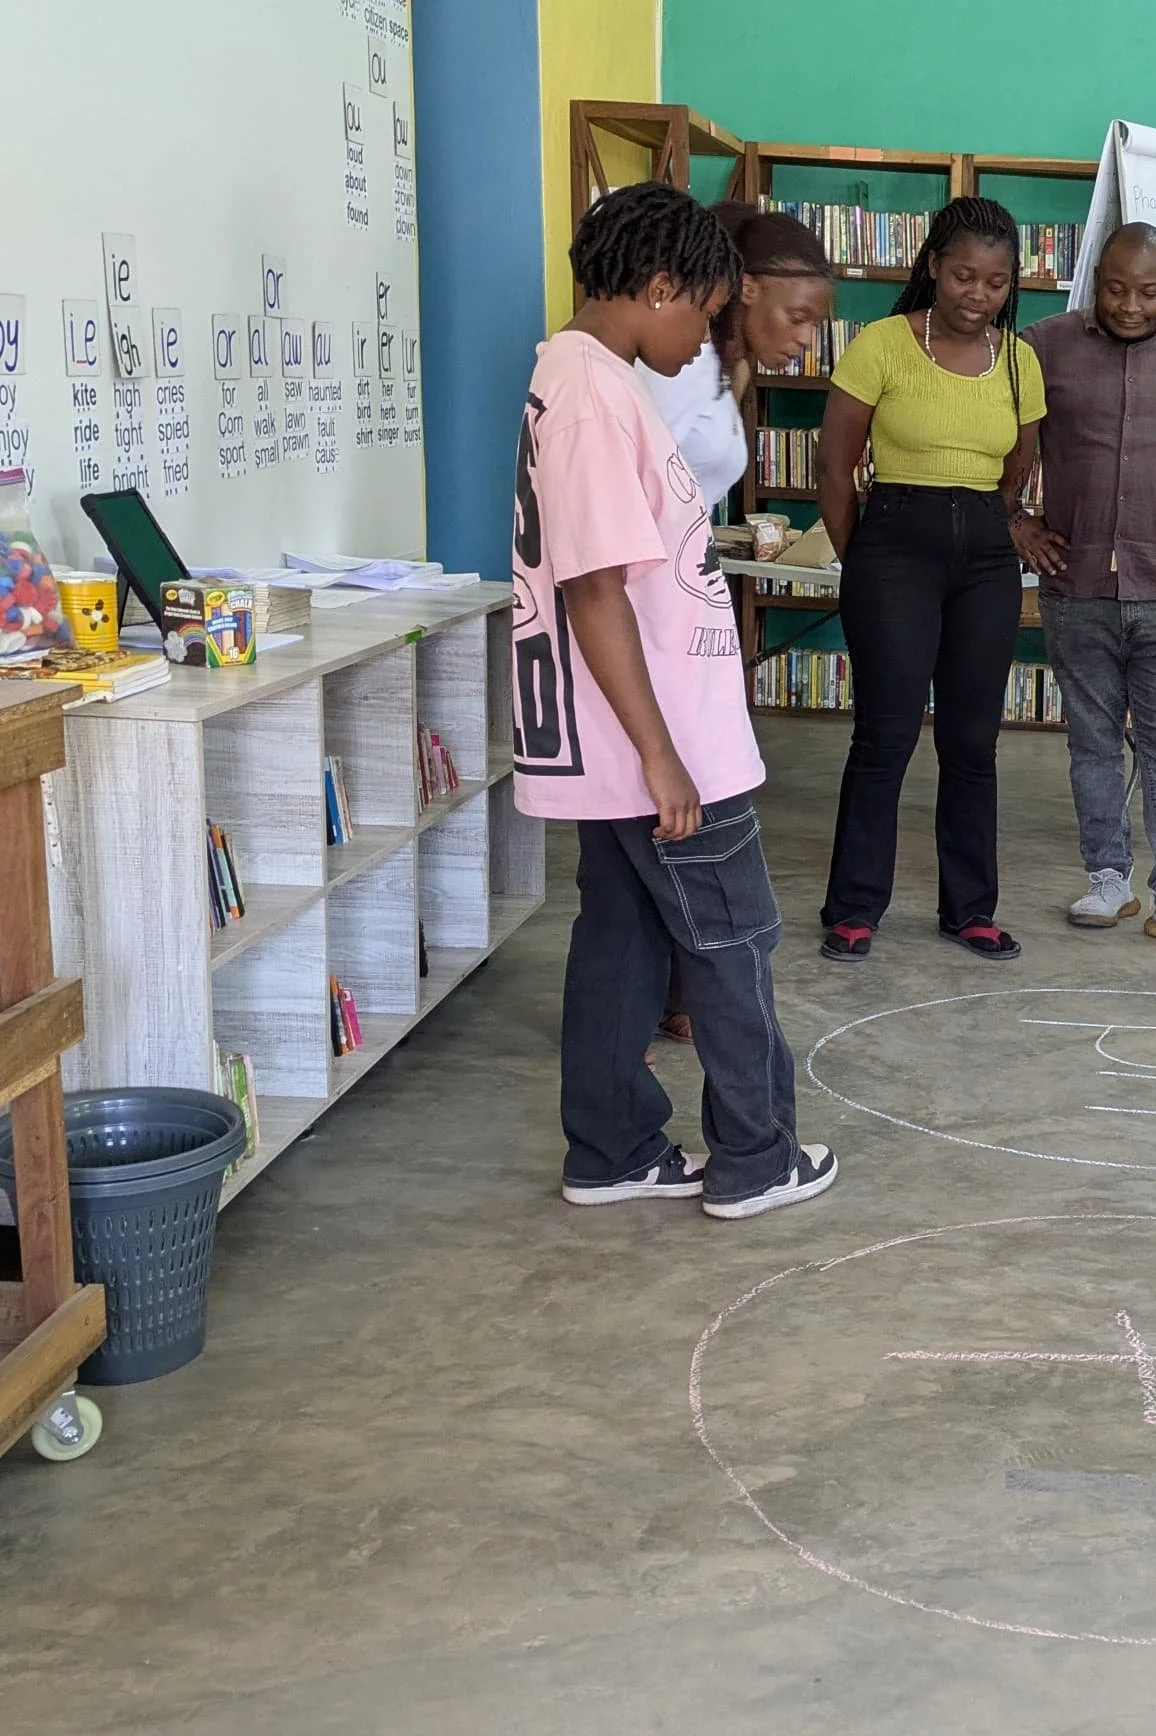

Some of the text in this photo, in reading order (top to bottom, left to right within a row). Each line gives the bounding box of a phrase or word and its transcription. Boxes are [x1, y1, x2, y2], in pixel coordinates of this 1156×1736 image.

[345, 172, 367, 193] about
[347, 202, 368, 226] found
[112, 254, 131, 301] ie
[266, 268, 283, 309] or
[114, 323, 141, 376] igh
[160, 322, 179, 368] ie
[216, 329, 236, 368] or
[251, 320, 269, 366] al
[283, 331, 302, 366] aw
[316, 331, 331, 366] au
[381, 331, 394, 372] er
[0, 384, 16, 413] oy
[72, 383, 97, 407] kite
[113, 382, 141, 412] high
[157, 381, 184, 404] cries
[222, 382, 236, 403] for
[257, 380, 269, 401] all
[285, 380, 303, 398] saw
[309, 381, 342, 401] haunted
[357, 379, 370, 396] dirt
[382, 381, 393, 397] her
[285, 408, 306, 432] lawn
[356, 400, 371, 420] bird
[380, 404, 396, 421] herb
[74, 417, 100, 444] ride
[115, 421, 144, 453] tight
[158, 414, 190, 444] spied
[254, 414, 276, 437] walk
[317, 418, 335, 438] fault
[356, 428, 373, 446] shirt
[378, 423, 400, 446] singer
[404, 426, 421, 443] burst
[0, 421, 29, 457] njoy
[282, 432, 309, 458] prawn
[219, 443, 246, 469] sport
[254, 439, 280, 467] small
[80, 457, 100, 482] life
[163, 456, 189, 486] fried
